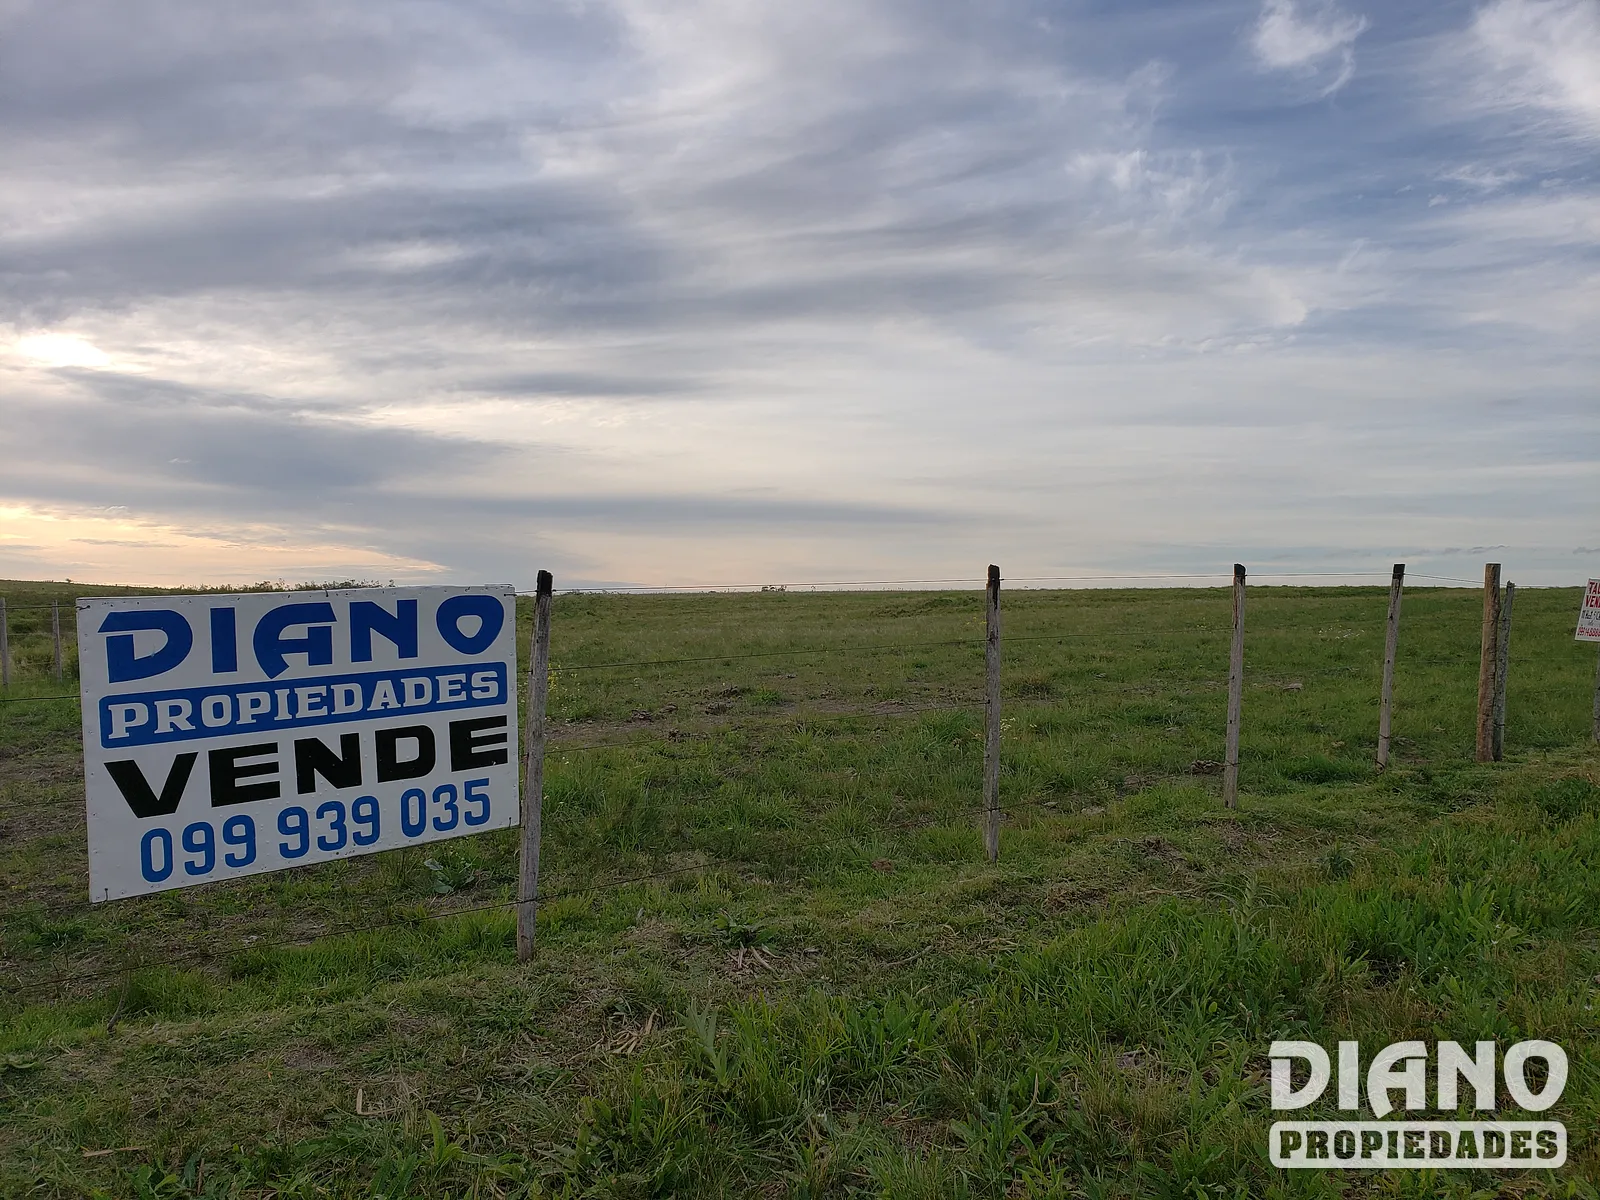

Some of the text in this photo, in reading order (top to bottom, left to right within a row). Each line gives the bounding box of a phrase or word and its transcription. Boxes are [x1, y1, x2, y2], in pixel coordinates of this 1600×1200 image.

[97, 595, 505, 683] DIANO
[108, 670, 499, 739] PROPIEDADES
[103, 715, 508, 819] VENDE
[140, 778, 490, 883] 099 939 035
